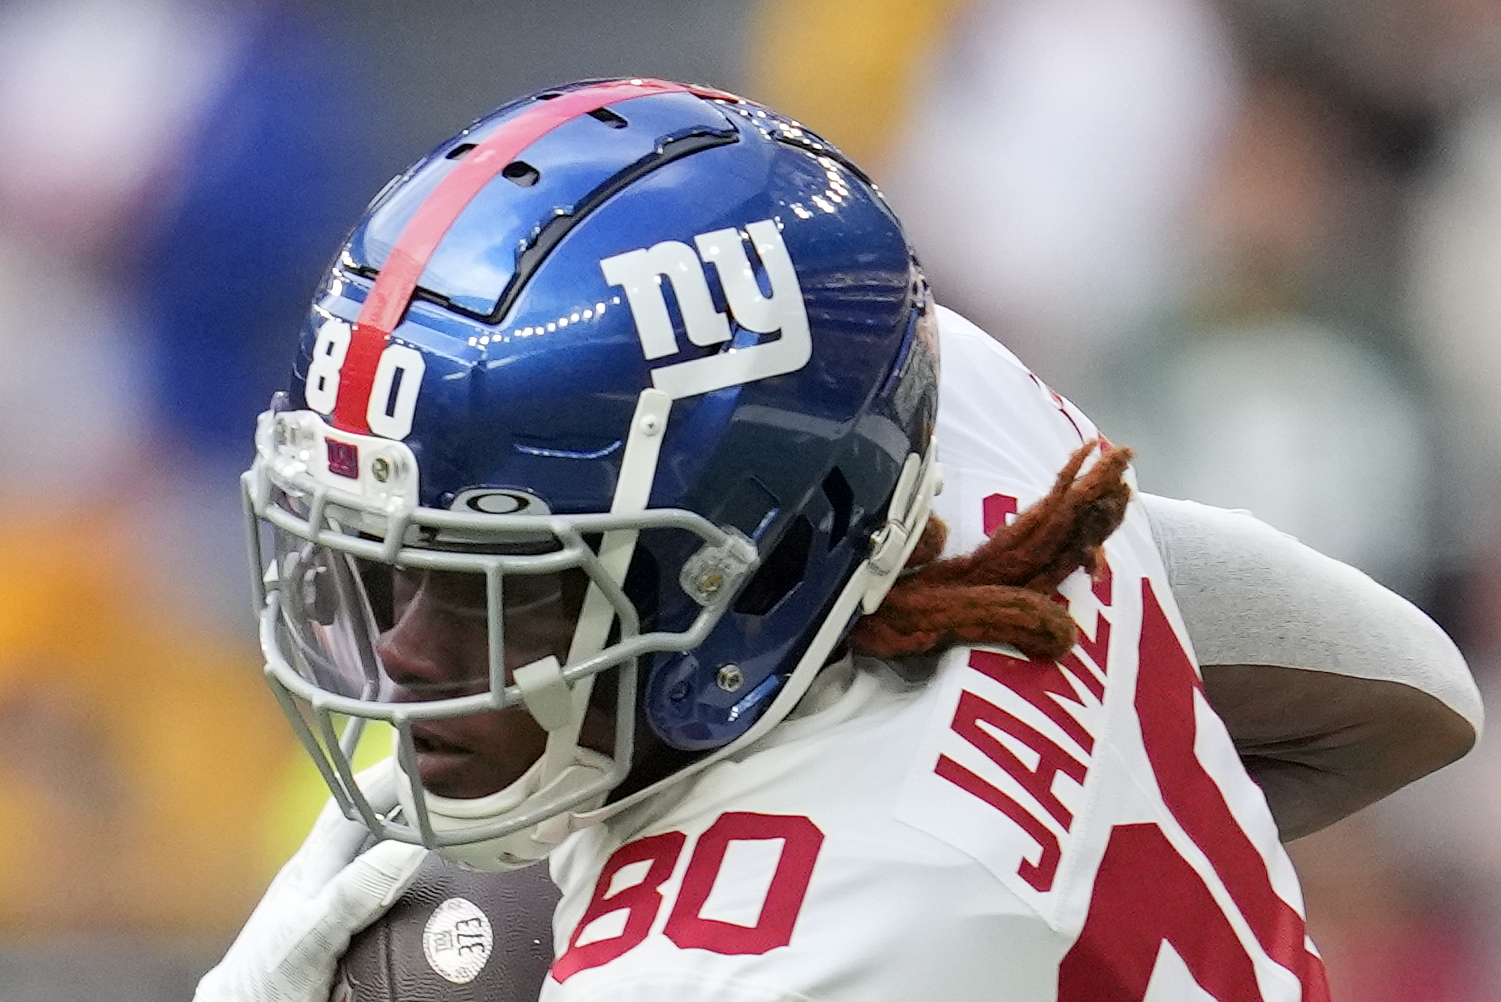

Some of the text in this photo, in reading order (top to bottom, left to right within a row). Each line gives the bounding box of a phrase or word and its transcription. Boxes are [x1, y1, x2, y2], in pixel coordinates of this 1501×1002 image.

[303, 319, 427, 440] 80
[455, 917, 486, 956] 373
[551, 811, 825, 985] 80
